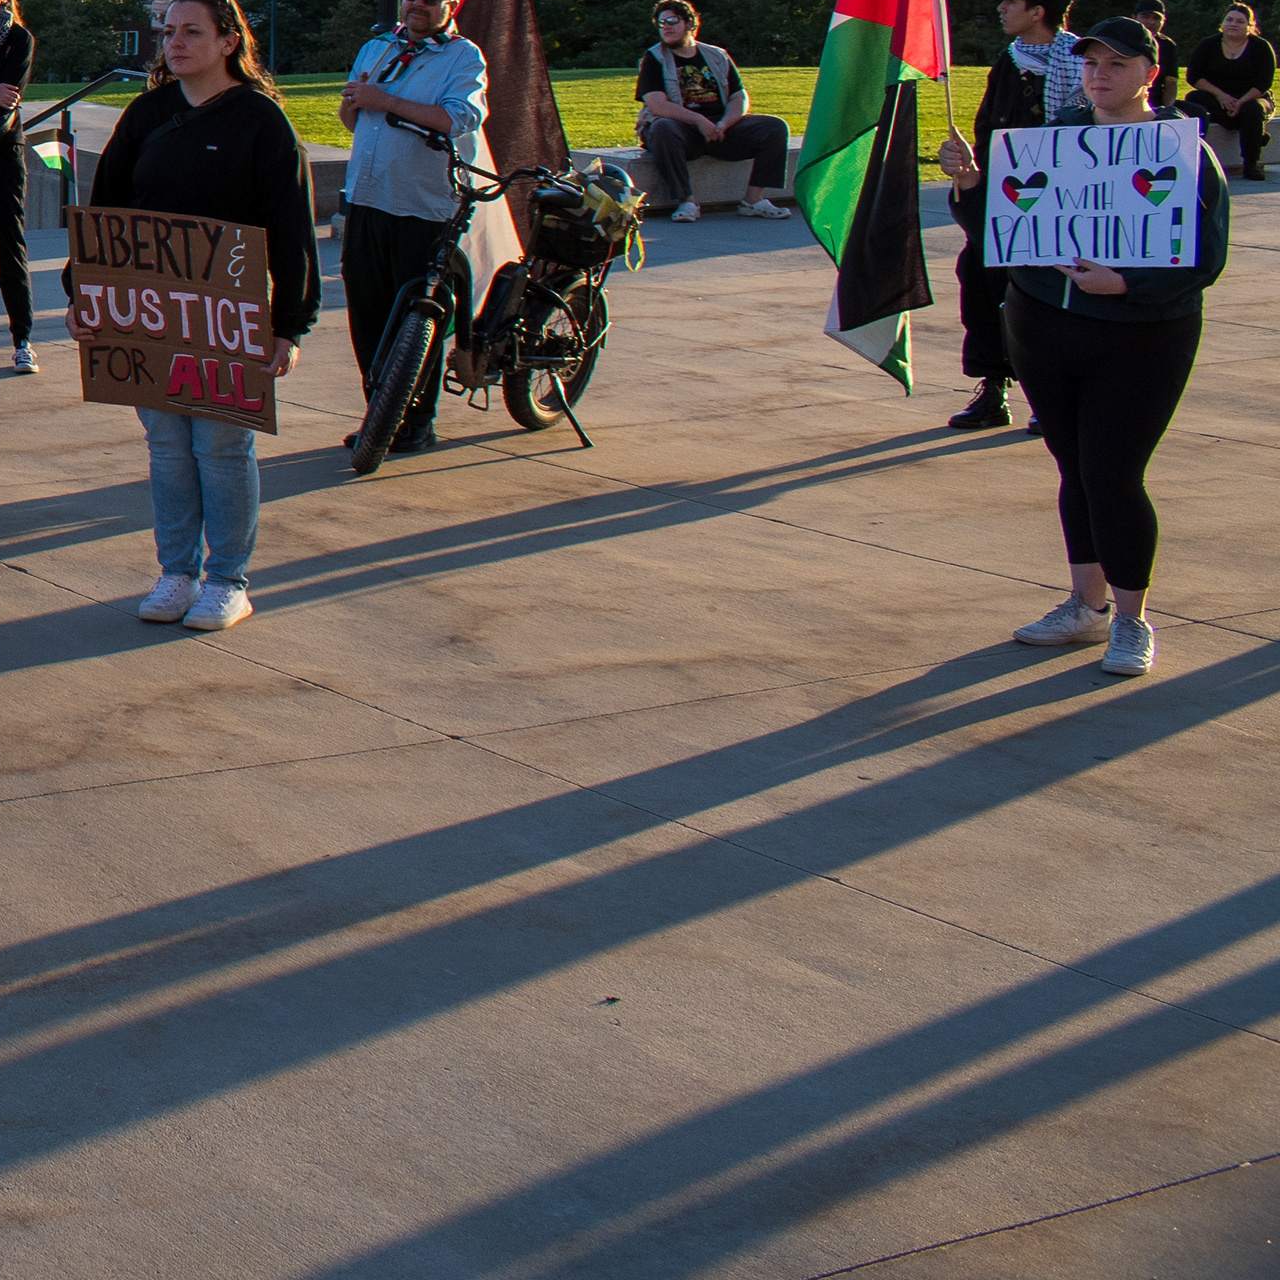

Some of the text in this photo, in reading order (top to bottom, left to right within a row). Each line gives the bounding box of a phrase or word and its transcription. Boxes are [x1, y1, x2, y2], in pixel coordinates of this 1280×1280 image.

[1002, 122, 1181, 169] WE STAND
[1055, 181, 1114, 210] WITH
[73, 210, 224, 282] LIBERTY
[79, 283, 267, 357] JUSTICE
[88, 346, 265, 412] FOR ALL
